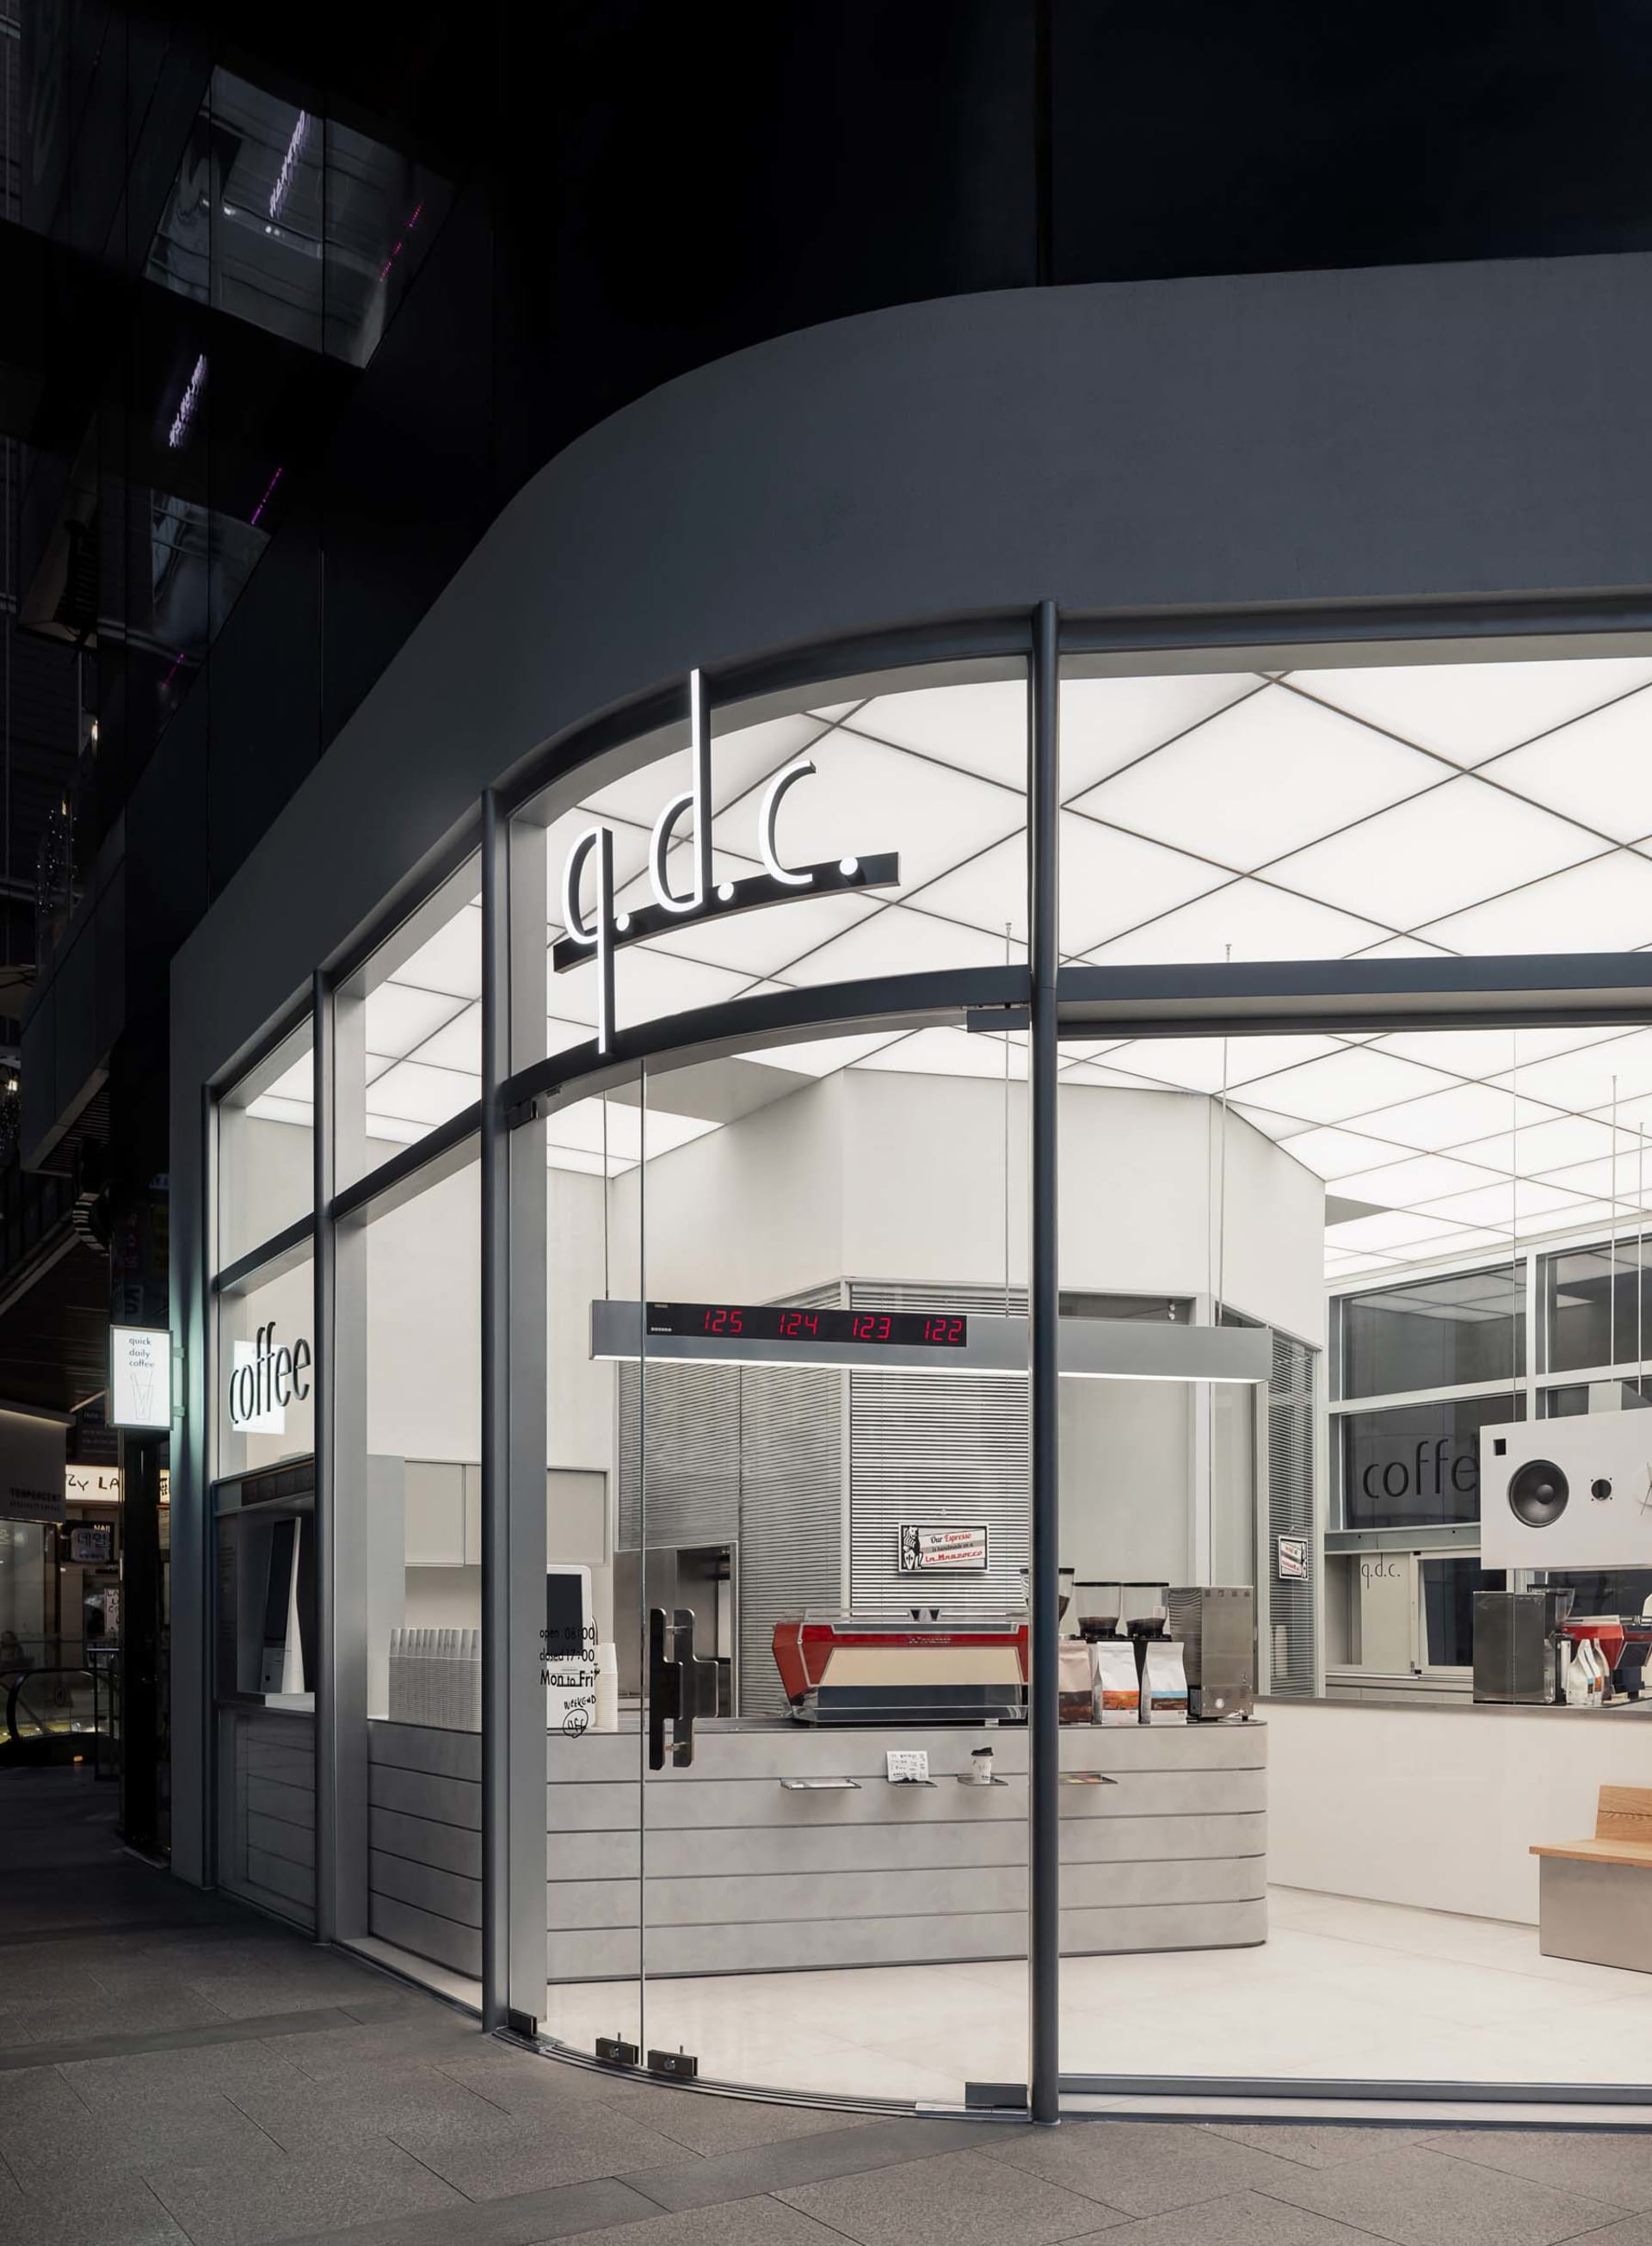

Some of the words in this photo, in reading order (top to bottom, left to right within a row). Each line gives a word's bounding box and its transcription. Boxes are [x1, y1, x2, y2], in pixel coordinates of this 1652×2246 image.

[561, 668, 858, 1054] q.d.c.
[704, 1310, 743, 1334] 125
[779, 1313, 818, 1336] 124
[852, 1317, 891, 1340] 123
[924, 1319, 963, 1342] 122
[128, 1336, 151, 1346] quick
[128, 1348, 151, 1359] daily
[128, 1359, 155, 1367] coffee
[228, 1321, 311, 1425] coffee
[945, 1533, 971, 1542] Espresso
[1361, 1552, 1401, 1589] q.d.c.
[539, 1629, 559, 1641] open
[539, 1646, 564, 1661] closed
[540, 1669, 564, 1686] Mon
[567, 1675, 576, 1687] to
[580, 1670, 593, 1688] Fri
